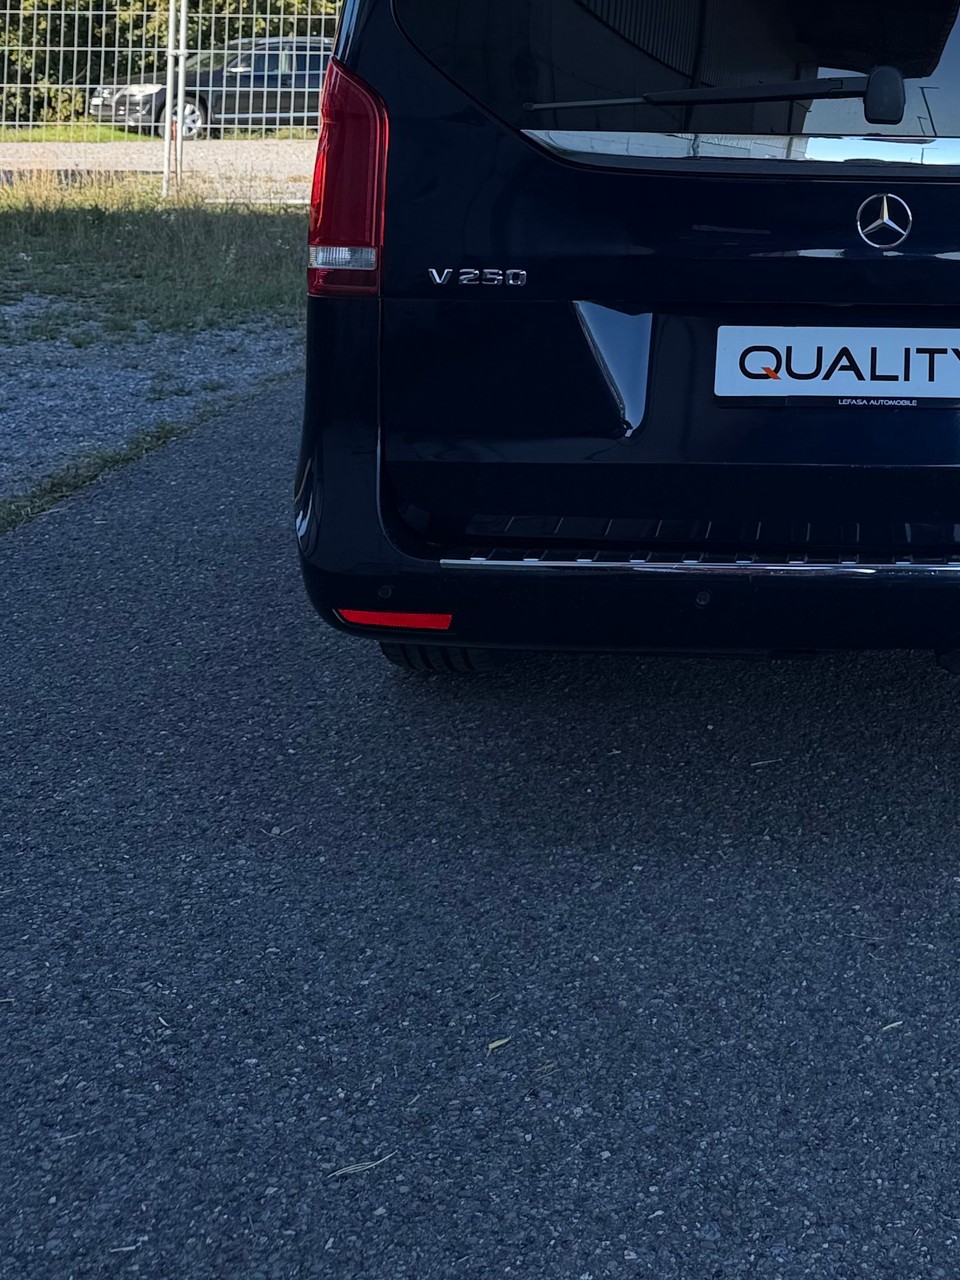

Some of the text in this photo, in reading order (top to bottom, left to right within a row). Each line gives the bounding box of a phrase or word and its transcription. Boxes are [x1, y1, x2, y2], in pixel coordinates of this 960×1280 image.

[428, 268, 527, 286] V 250
[869, 399, 917, 407] AUTOMOBILE
